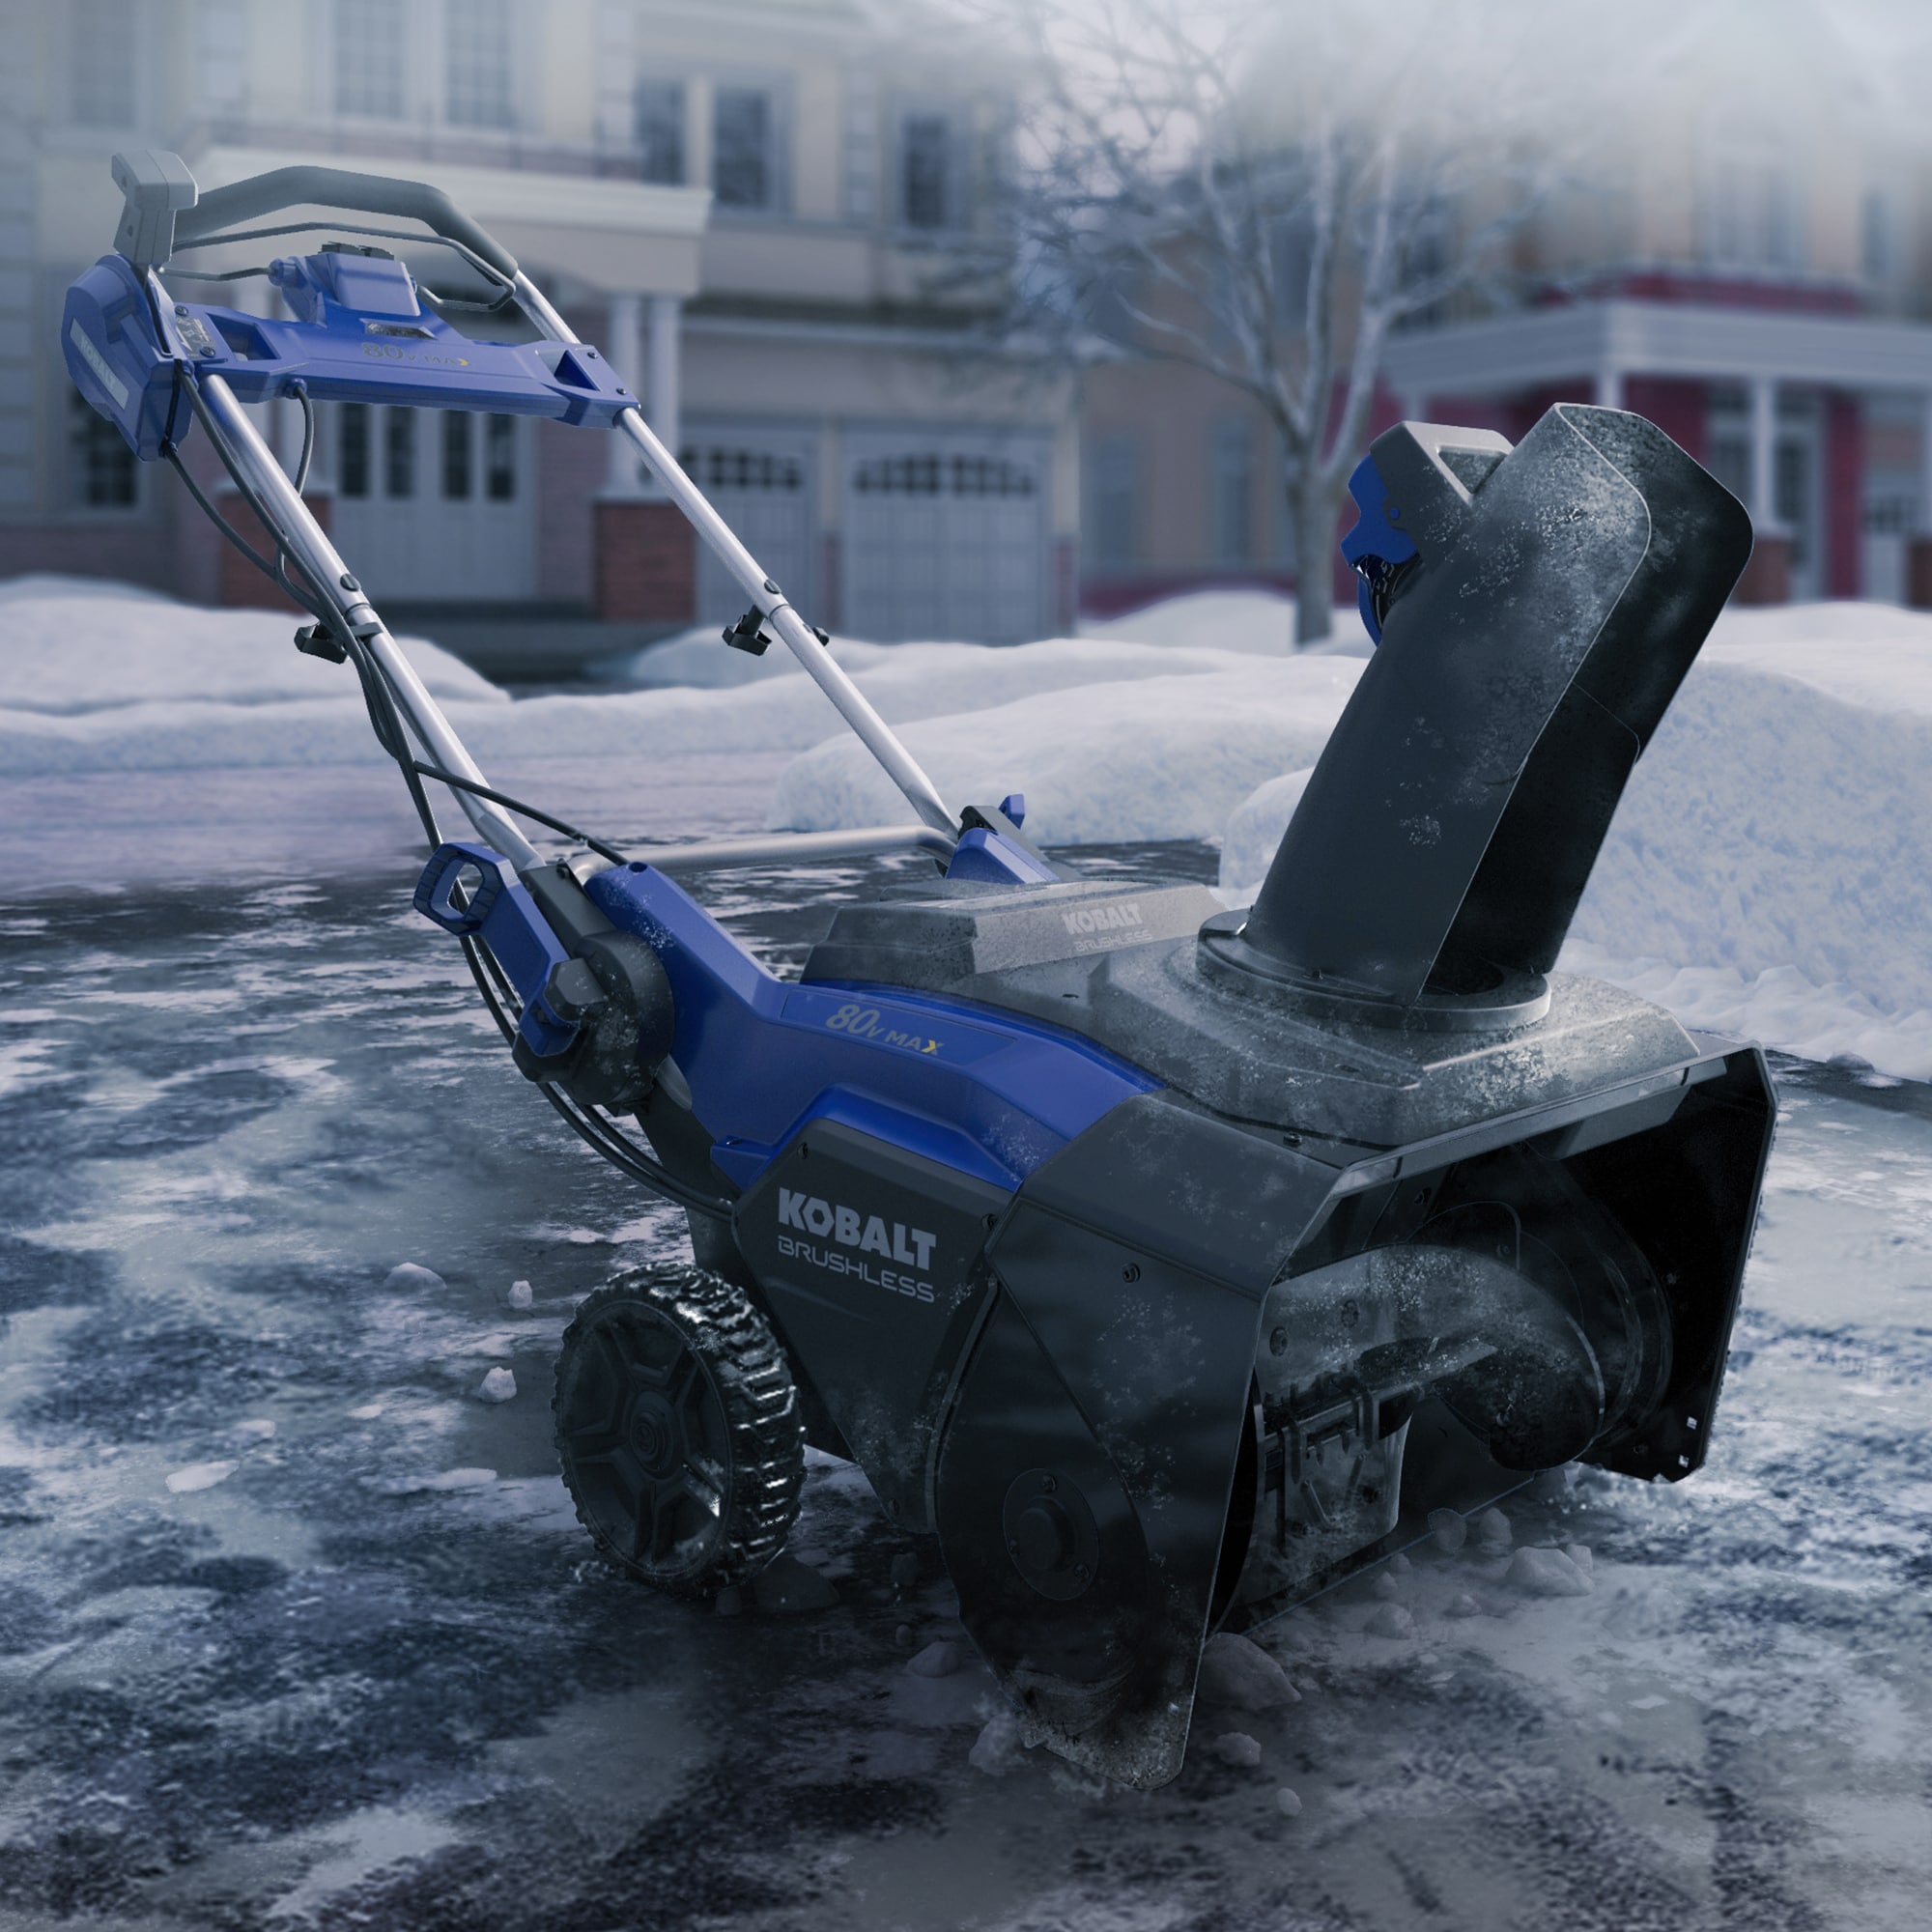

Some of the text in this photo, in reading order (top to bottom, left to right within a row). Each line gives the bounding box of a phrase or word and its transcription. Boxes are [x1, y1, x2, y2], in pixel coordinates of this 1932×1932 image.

[1061, 902, 1143, 935] KOBALT
[1073, 929, 1152, 952] BRUSHLESS
[884, 1030, 945, 1056] MAX
[778, 1186, 937, 1271] KOBALT
[777, 1235, 936, 1303] BRUSHLESS
